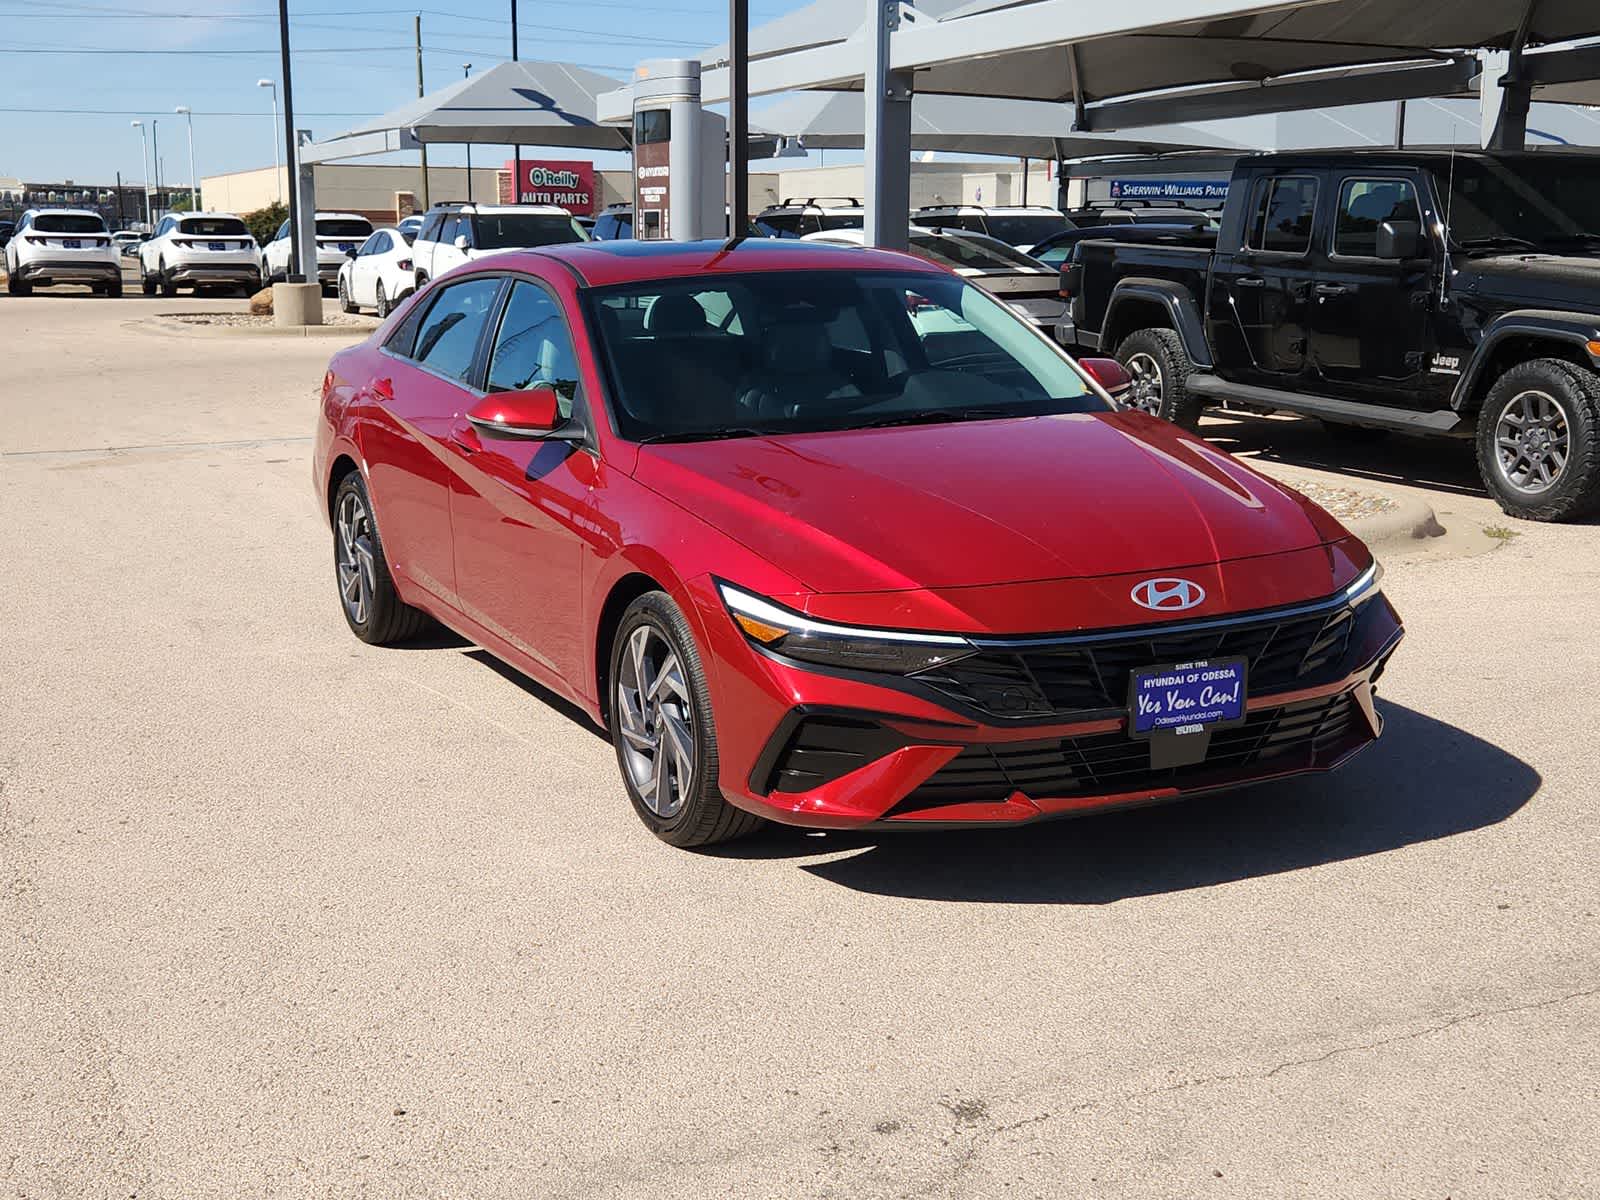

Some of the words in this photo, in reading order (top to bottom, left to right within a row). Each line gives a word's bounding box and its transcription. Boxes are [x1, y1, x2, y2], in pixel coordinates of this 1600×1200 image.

[530, 168, 579, 188] O'Reilly
[521, 192, 551, 203] AUTO
[553, 193, 589, 204] PARTS
[1122, 184, 1203, 196] SHERWIN-WILLIAMS
[1432, 352, 1460, 369] Jeep
[1144, 676, 1184, 688] HYUNDAI
[1186, 674, 1200, 683] OF
[1201, 669, 1236, 681] ODESSA
[1138, 694, 1162, 715] Yes
[1167, 690, 1196, 712] You
[1200, 681, 1239, 707] Can!
[1154, 710, 1223, 725] OdessaHyundai.com
